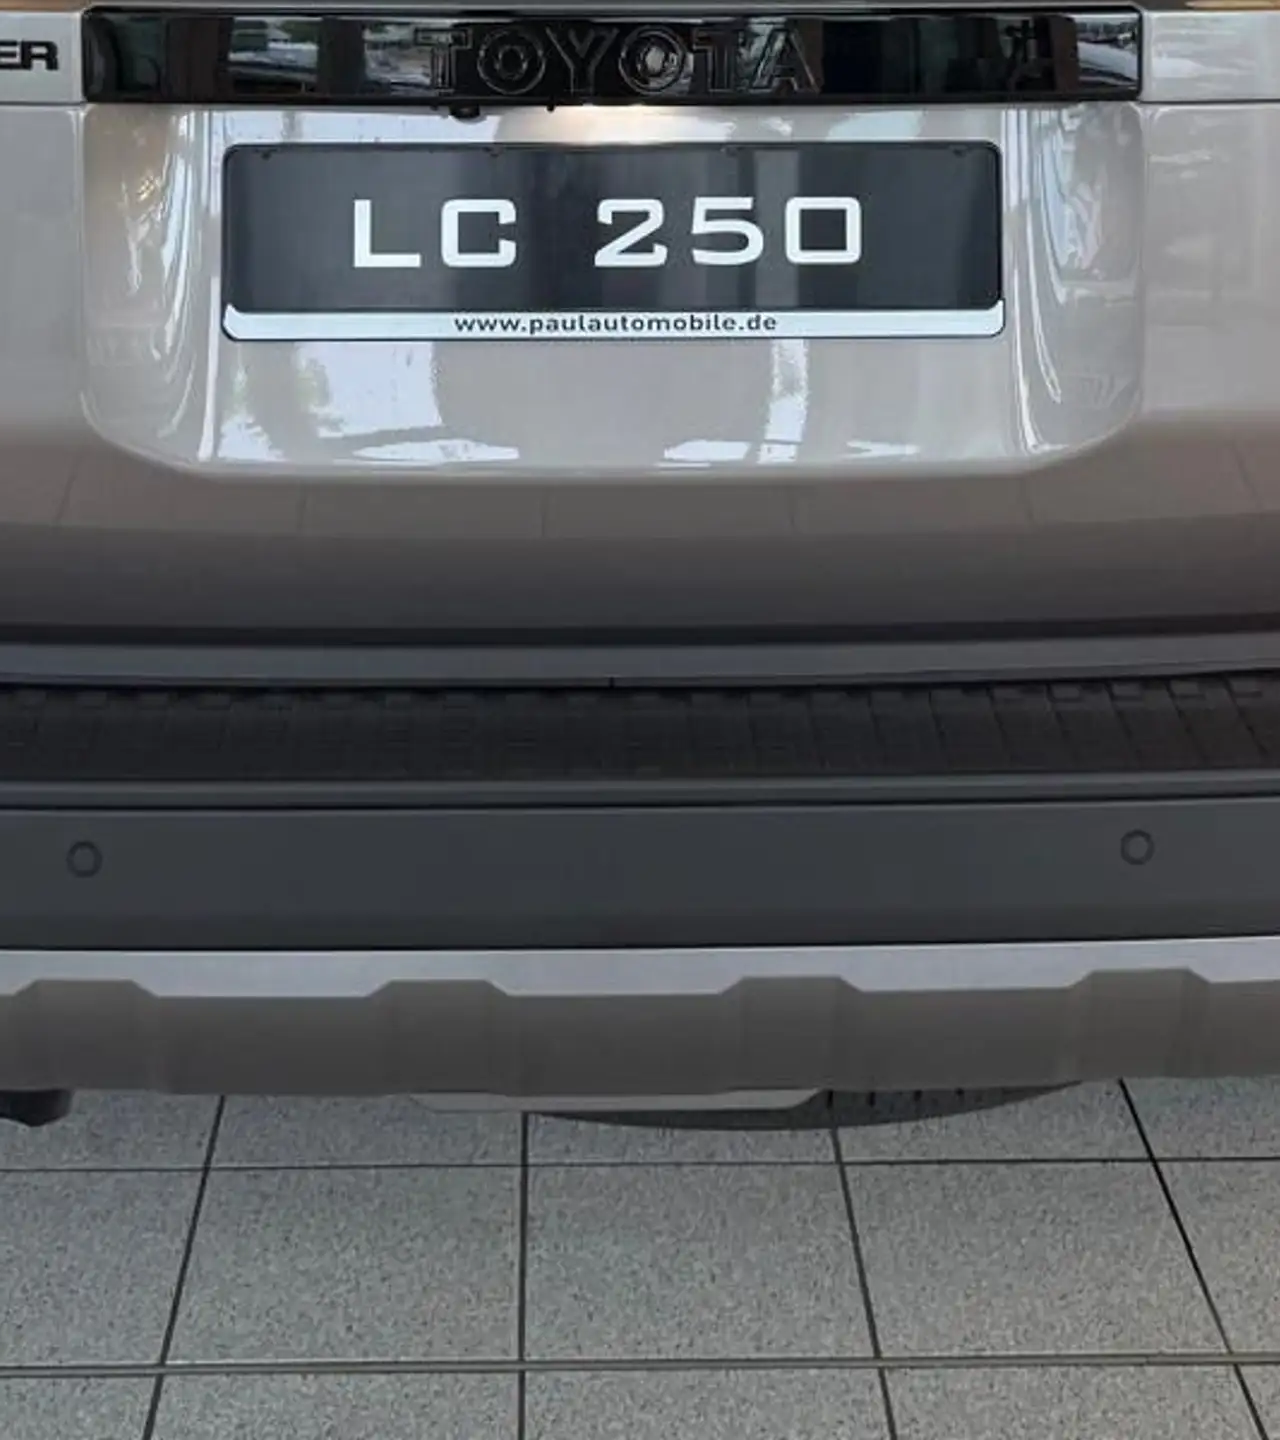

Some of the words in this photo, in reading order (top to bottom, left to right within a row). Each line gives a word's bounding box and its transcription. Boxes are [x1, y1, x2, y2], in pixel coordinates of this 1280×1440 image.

[414, 25, 823, 96] TOYOTA
[353, 198, 517, 268] LC
[594, 196, 863, 268] 250
[453, 311, 778, 334] www.paulautomobile.de
